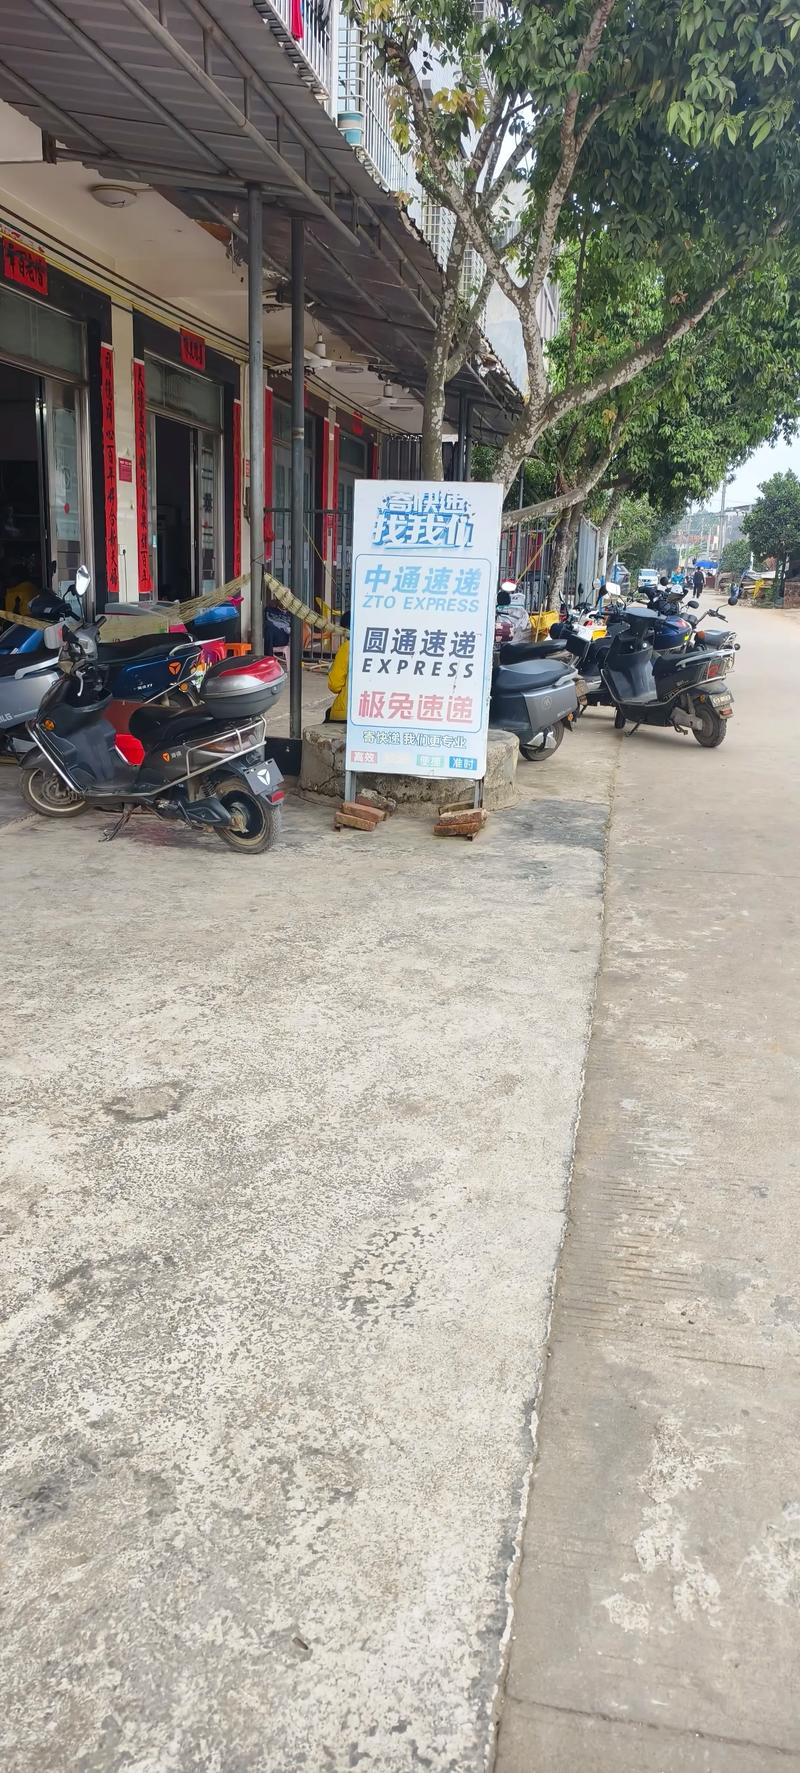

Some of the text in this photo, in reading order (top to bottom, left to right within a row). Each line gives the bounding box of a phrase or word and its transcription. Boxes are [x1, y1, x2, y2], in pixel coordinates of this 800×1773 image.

[364, 564, 481, 596] 中通速递
[362, 595, 480, 613] ZTO EXPRESS
[363, 627, 476, 659] 圆通速递
[362, 658, 474, 678] EXPRESS
[358, 691, 473, 723] 极兔速递
[452, 757, 474, 770] 准时
